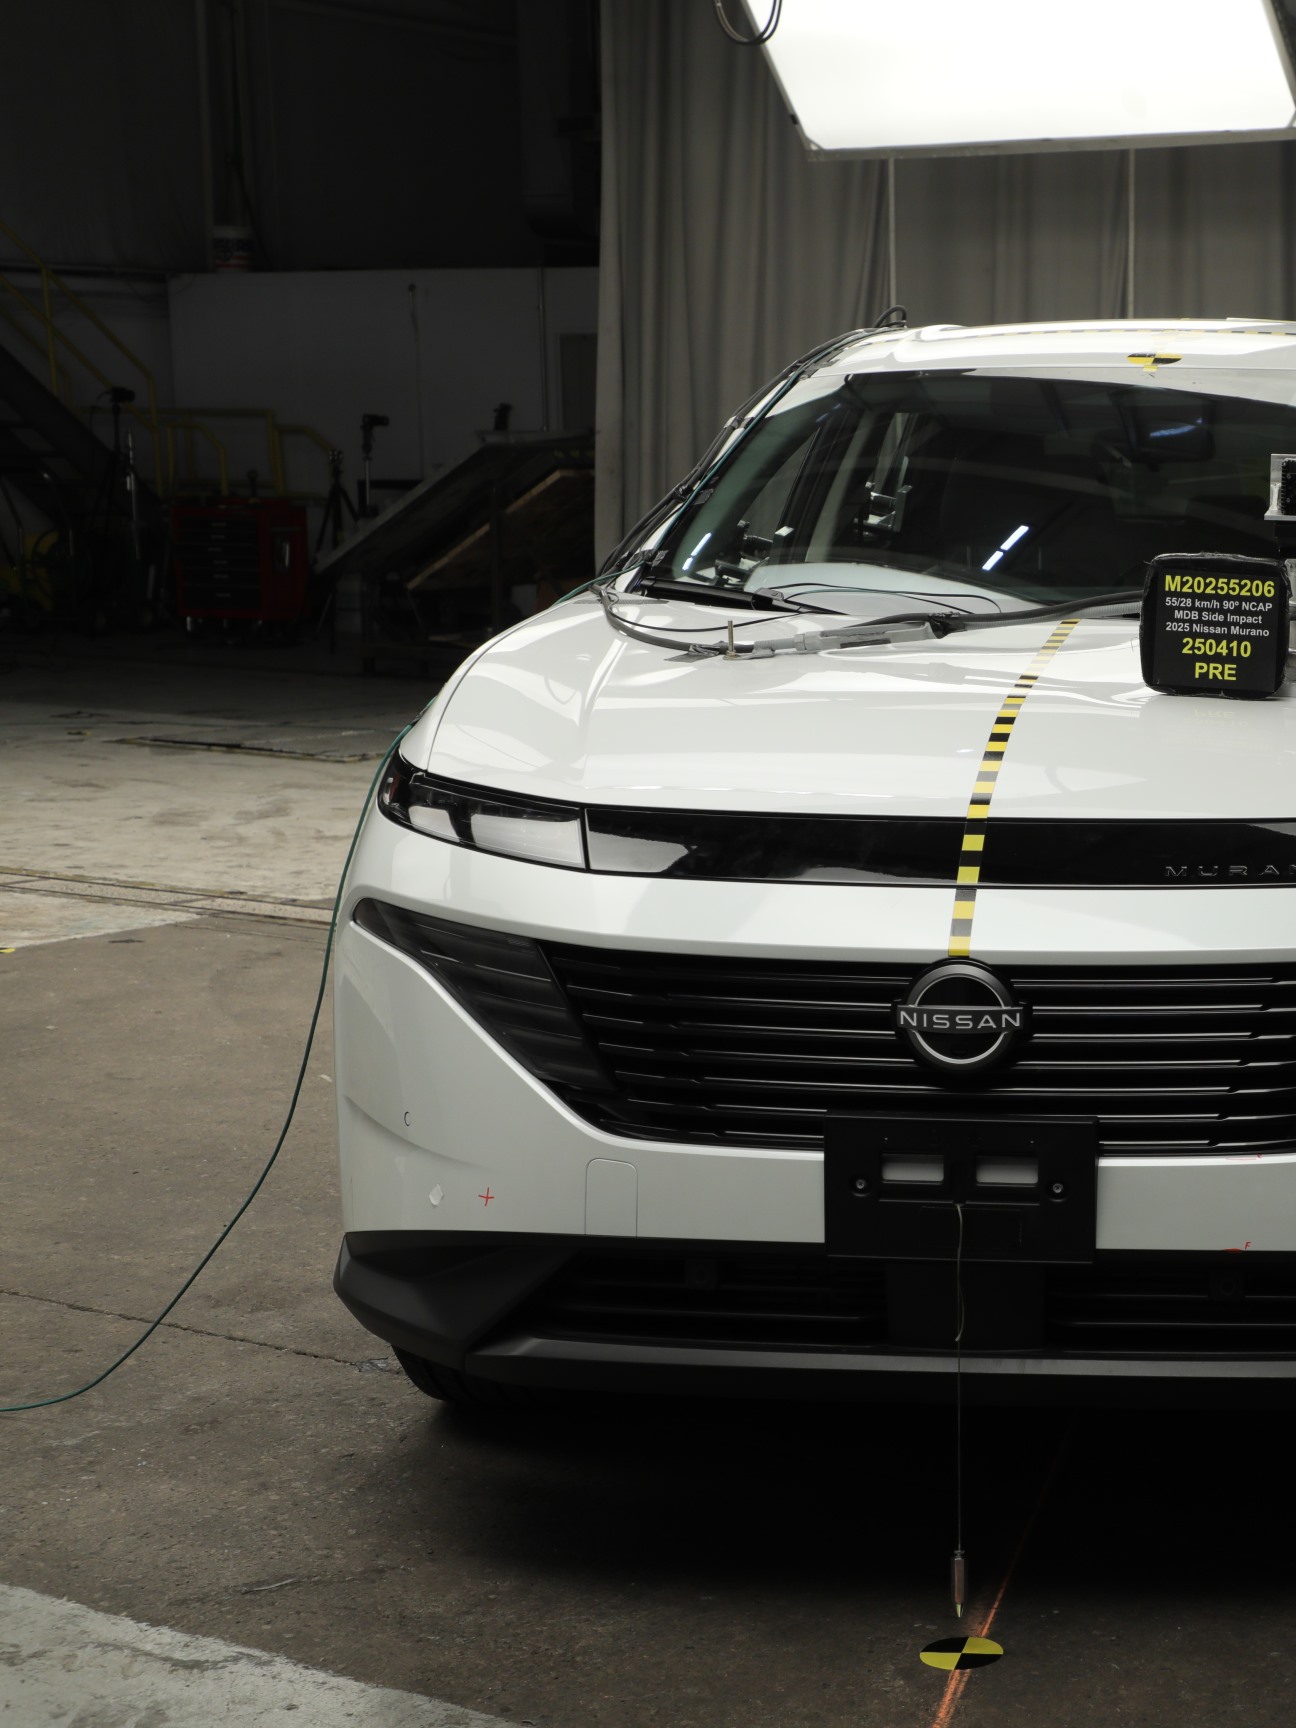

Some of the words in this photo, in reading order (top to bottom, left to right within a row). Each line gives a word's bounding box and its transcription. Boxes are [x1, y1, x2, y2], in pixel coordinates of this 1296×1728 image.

[1164, 574, 1275, 598] M20255206
[1165, 597, 1192, 608] 55/28
[1195, 598, 1220, 609] km/h
[1242, 602, 1272, 612] NCAP
[1174, 610, 1199, 620] MDB
[1202, 612, 1224, 622] Side
[1228, 613, 1262, 625] Impact
[1166, 622, 1190, 632] 2025
[1192, 624, 1228, 634] Nissan
[1230, 626, 1270, 636] Murano
[1182, 638, 1252, 658] 250410
[1194, 662, 1237, 680] PRE
[900, 1010, 1020, 1029] NISSAN
